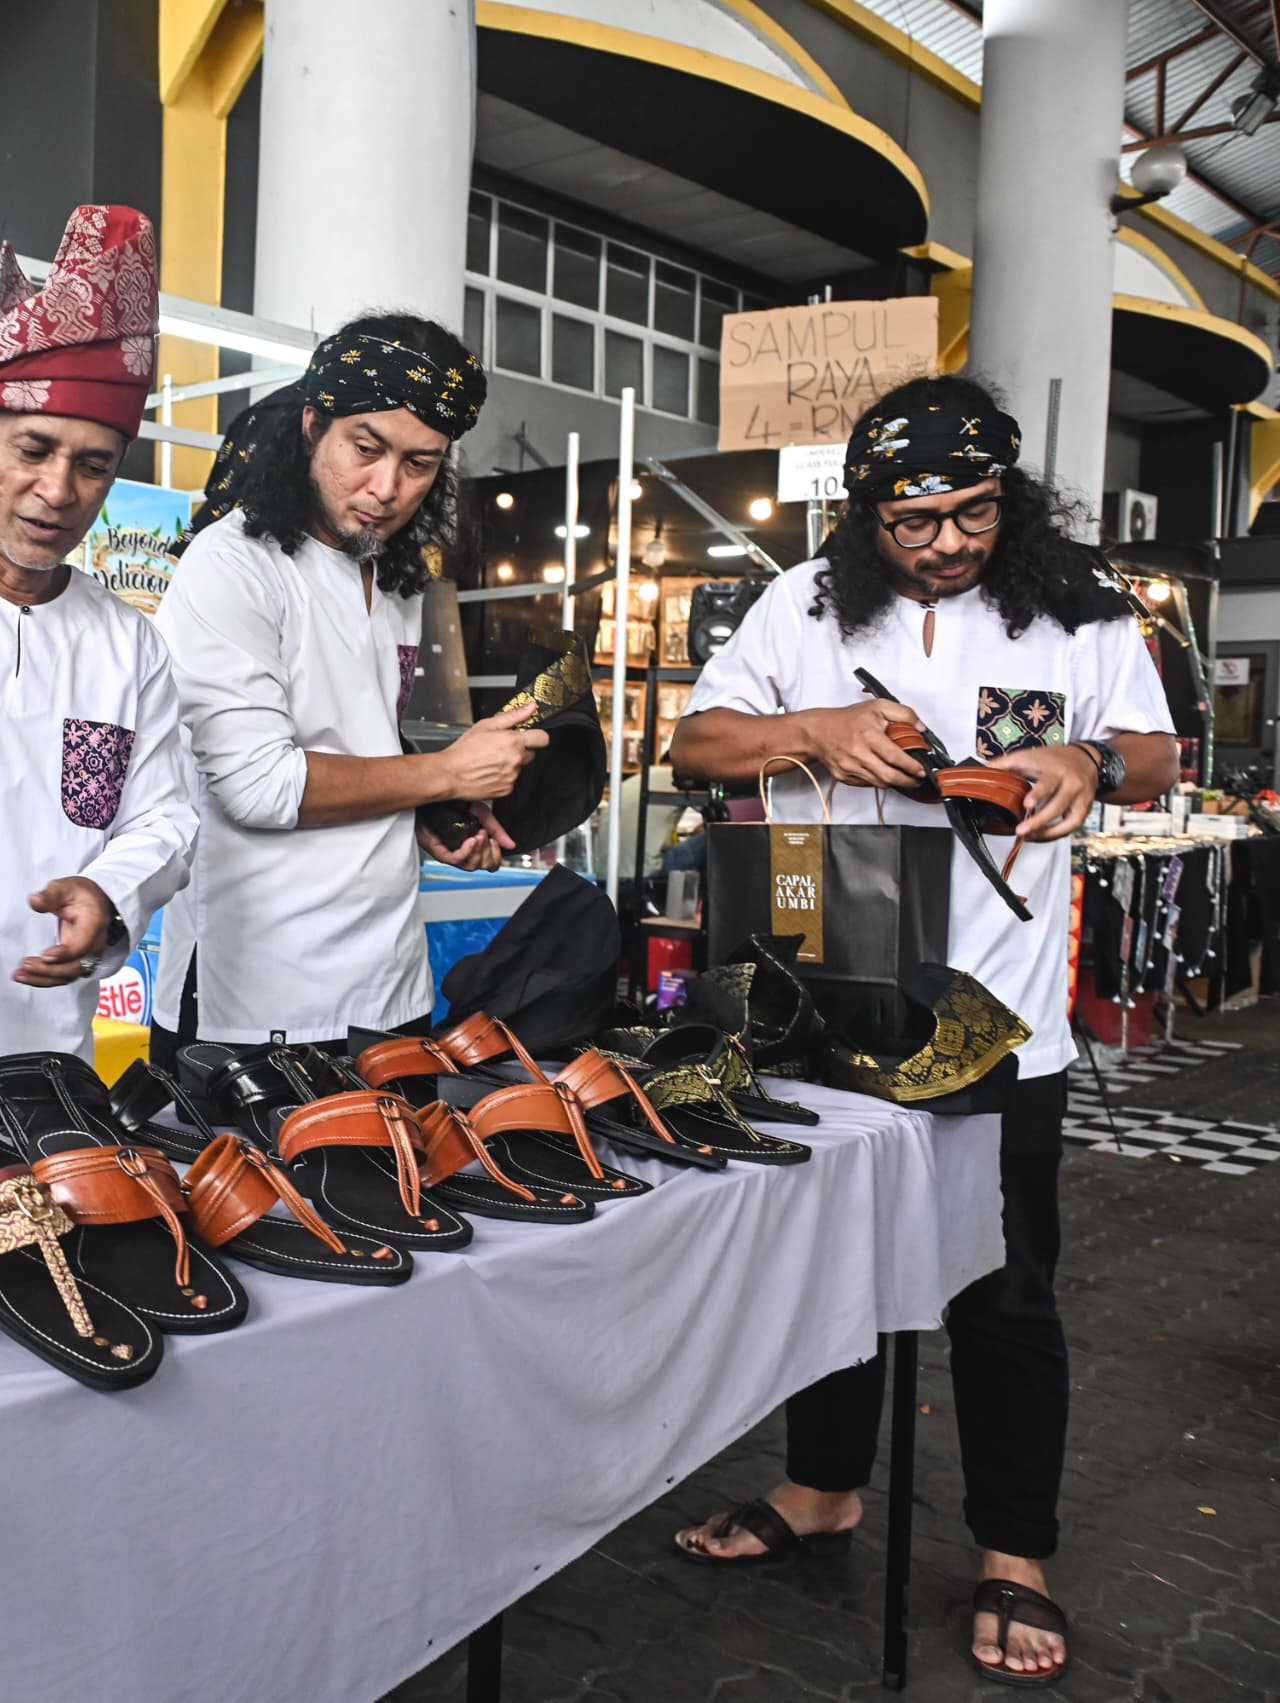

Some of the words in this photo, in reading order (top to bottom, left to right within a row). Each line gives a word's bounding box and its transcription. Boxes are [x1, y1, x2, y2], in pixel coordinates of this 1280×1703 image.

[729, 309, 907, 368] SAMPUL
[787, 356, 880, 405] RAYA
[744, 404, 782, 445] 4
[108, 528, 171, 558] Beyond
[776, 874, 816, 887] CAPAL
[776, 886, 816, 899] AKAR
[777, 897, 815, 910] UMBI
